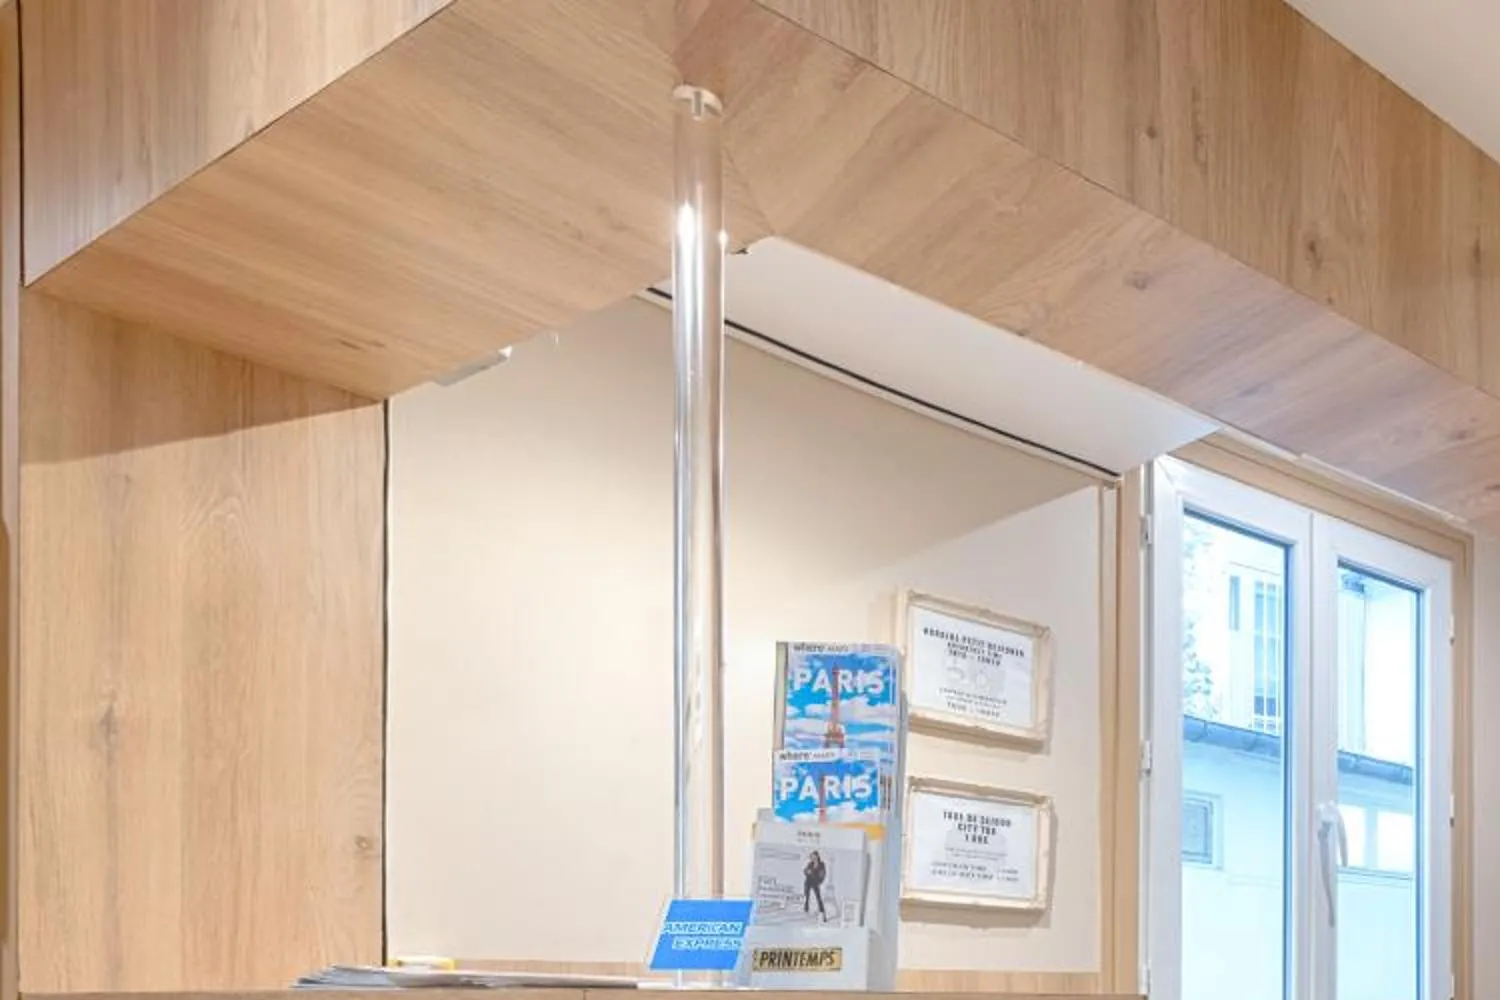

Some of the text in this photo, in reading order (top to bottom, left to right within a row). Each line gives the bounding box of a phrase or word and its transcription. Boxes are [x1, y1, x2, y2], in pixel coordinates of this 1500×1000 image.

[794, 668, 885, 696] PARIS
[781, 775, 873, 801] PARIS
[664, 921, 741, 934] AMERICAN
[673, 937, 742, 949] EXPRESS
[759, 951, 835, 967] PRINTEMPS
